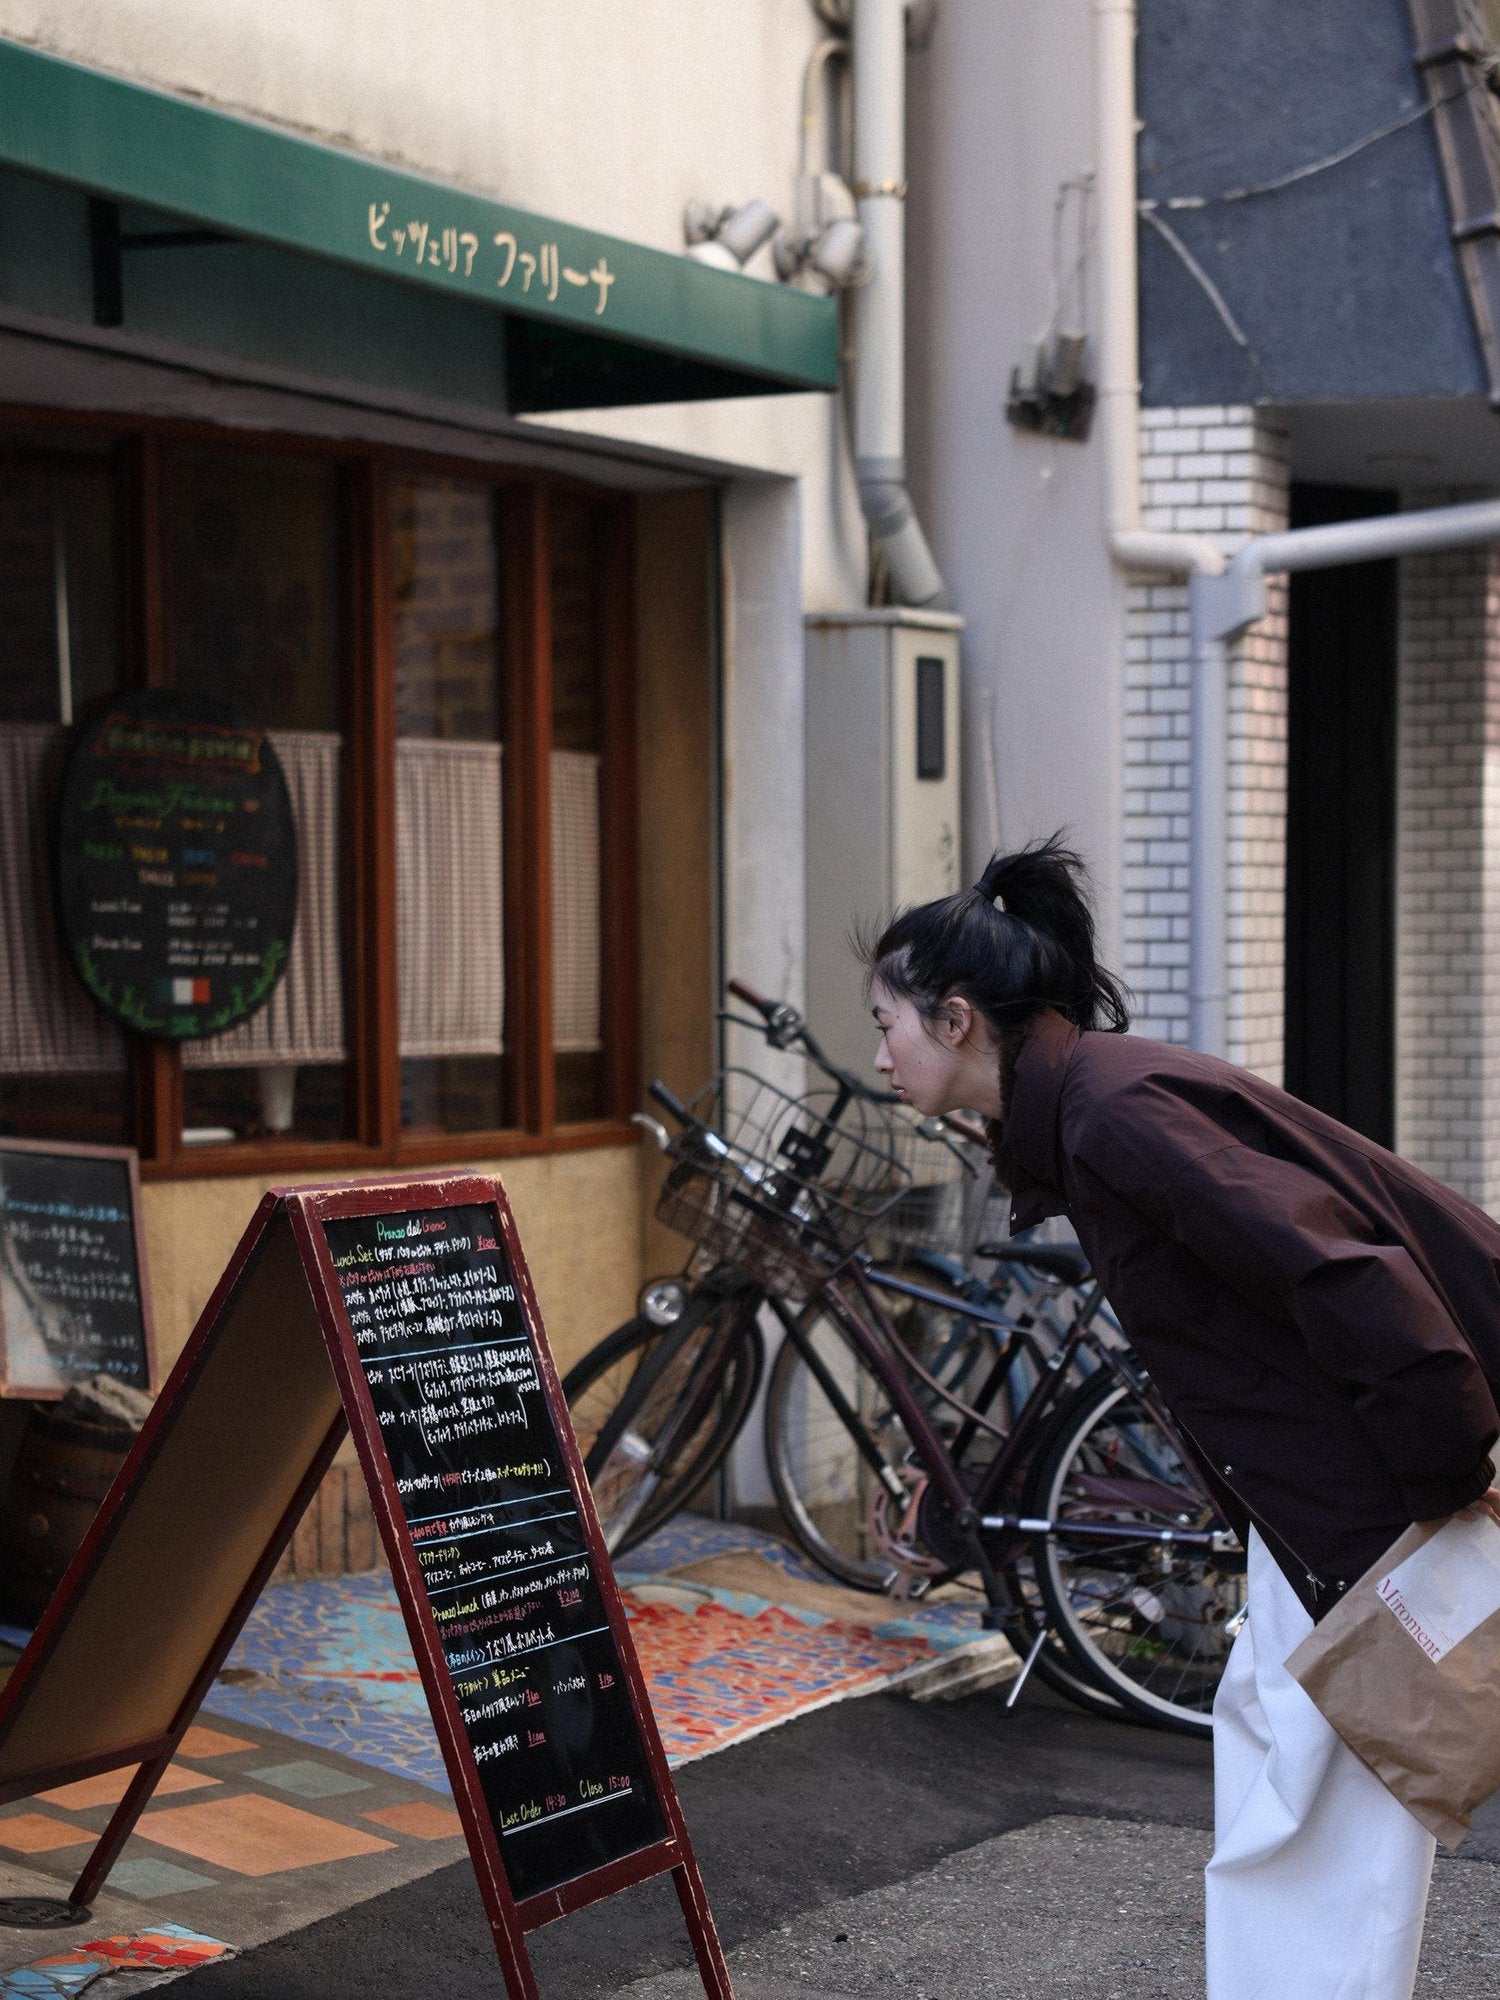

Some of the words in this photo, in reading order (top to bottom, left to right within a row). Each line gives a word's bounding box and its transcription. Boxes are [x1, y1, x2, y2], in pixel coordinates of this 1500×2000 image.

[368, 200, 480, 278] ピッツェリア
[494, 231, 616, 317] ファリーナ
[377, 1221, 405, 1241] Pranzo
[406, 1219, 422, 1237] del
[330, 1250, 357, 1269] Lunch
[357, 1244, 374, 1262] Set
[456, 1597, 479, 1615] Lunch
[1375, 1577, 1441, 1658] Miroment
[500, 1811, 520, 1829] Last
[520, 1800, 543, 1821] Order
[545, 1794, 567, 1813] 14:30
[579, 1780, 604, 1799] Close
[608, 1775, 631, 1791] 15:00
